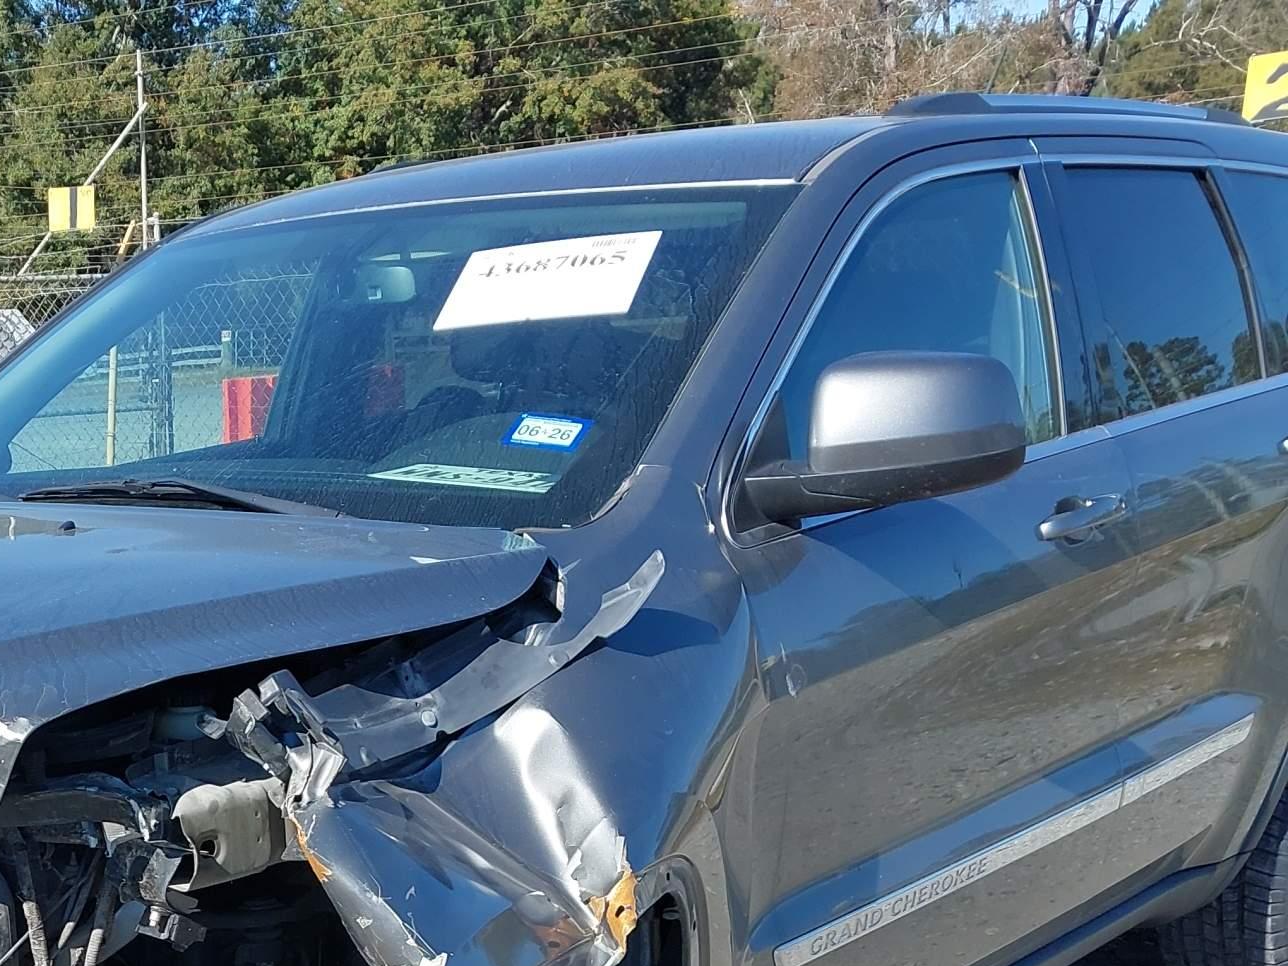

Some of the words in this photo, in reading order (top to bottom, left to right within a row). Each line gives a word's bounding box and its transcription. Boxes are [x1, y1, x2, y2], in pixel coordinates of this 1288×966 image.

[479, 250, 628, 278] 43687065
[517, 424, 542, 437] 06
[548, 427, 573, 441] 26
[809, 907, 884, 956] GRAND
[890, 856, 991, 917] CHEROKEE
